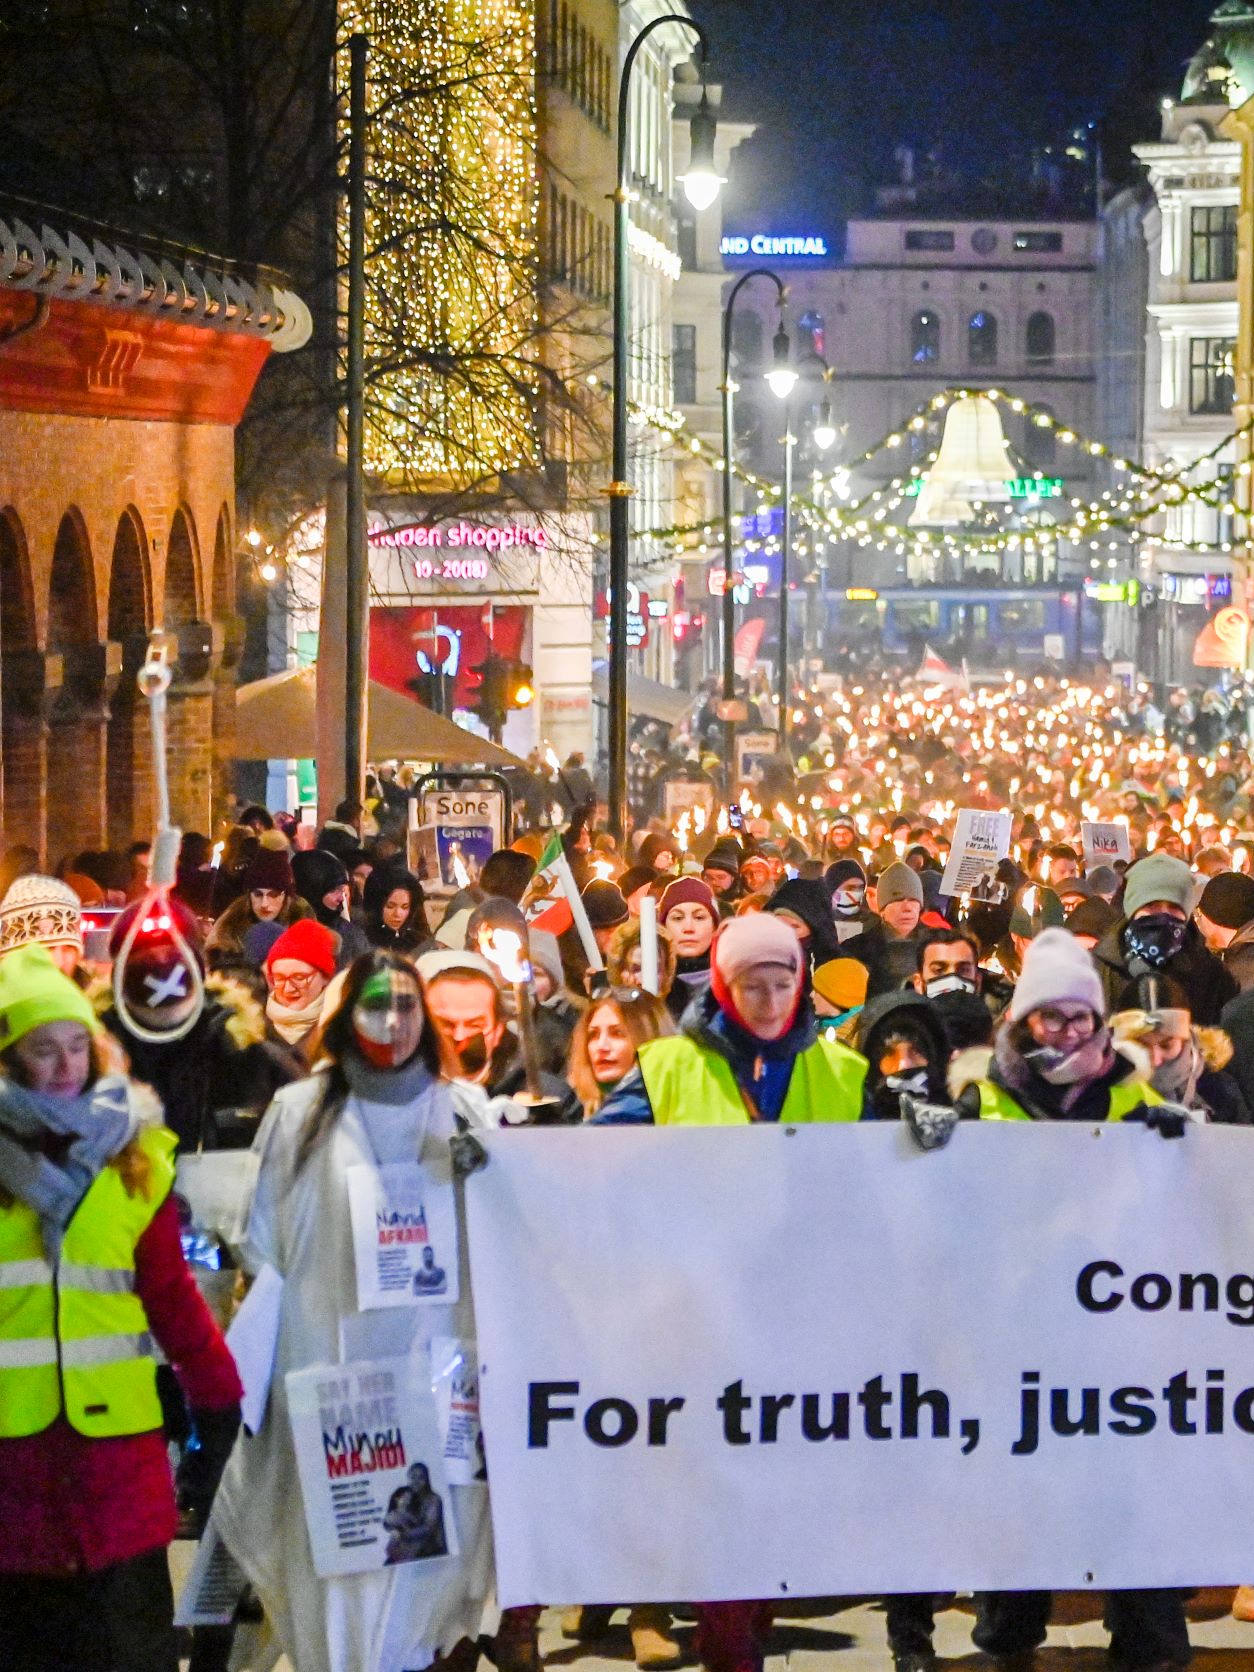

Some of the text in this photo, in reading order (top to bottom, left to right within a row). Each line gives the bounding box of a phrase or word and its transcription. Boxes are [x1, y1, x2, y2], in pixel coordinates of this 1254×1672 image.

[719, 234, 827, 254] ND CENTRAL
[448, 521, 548, 552] shopping
[437, 796, 489, 815] Sone
[528, 1381, 685, 1449] For
[716, 1372, 981, 1455] truth,
